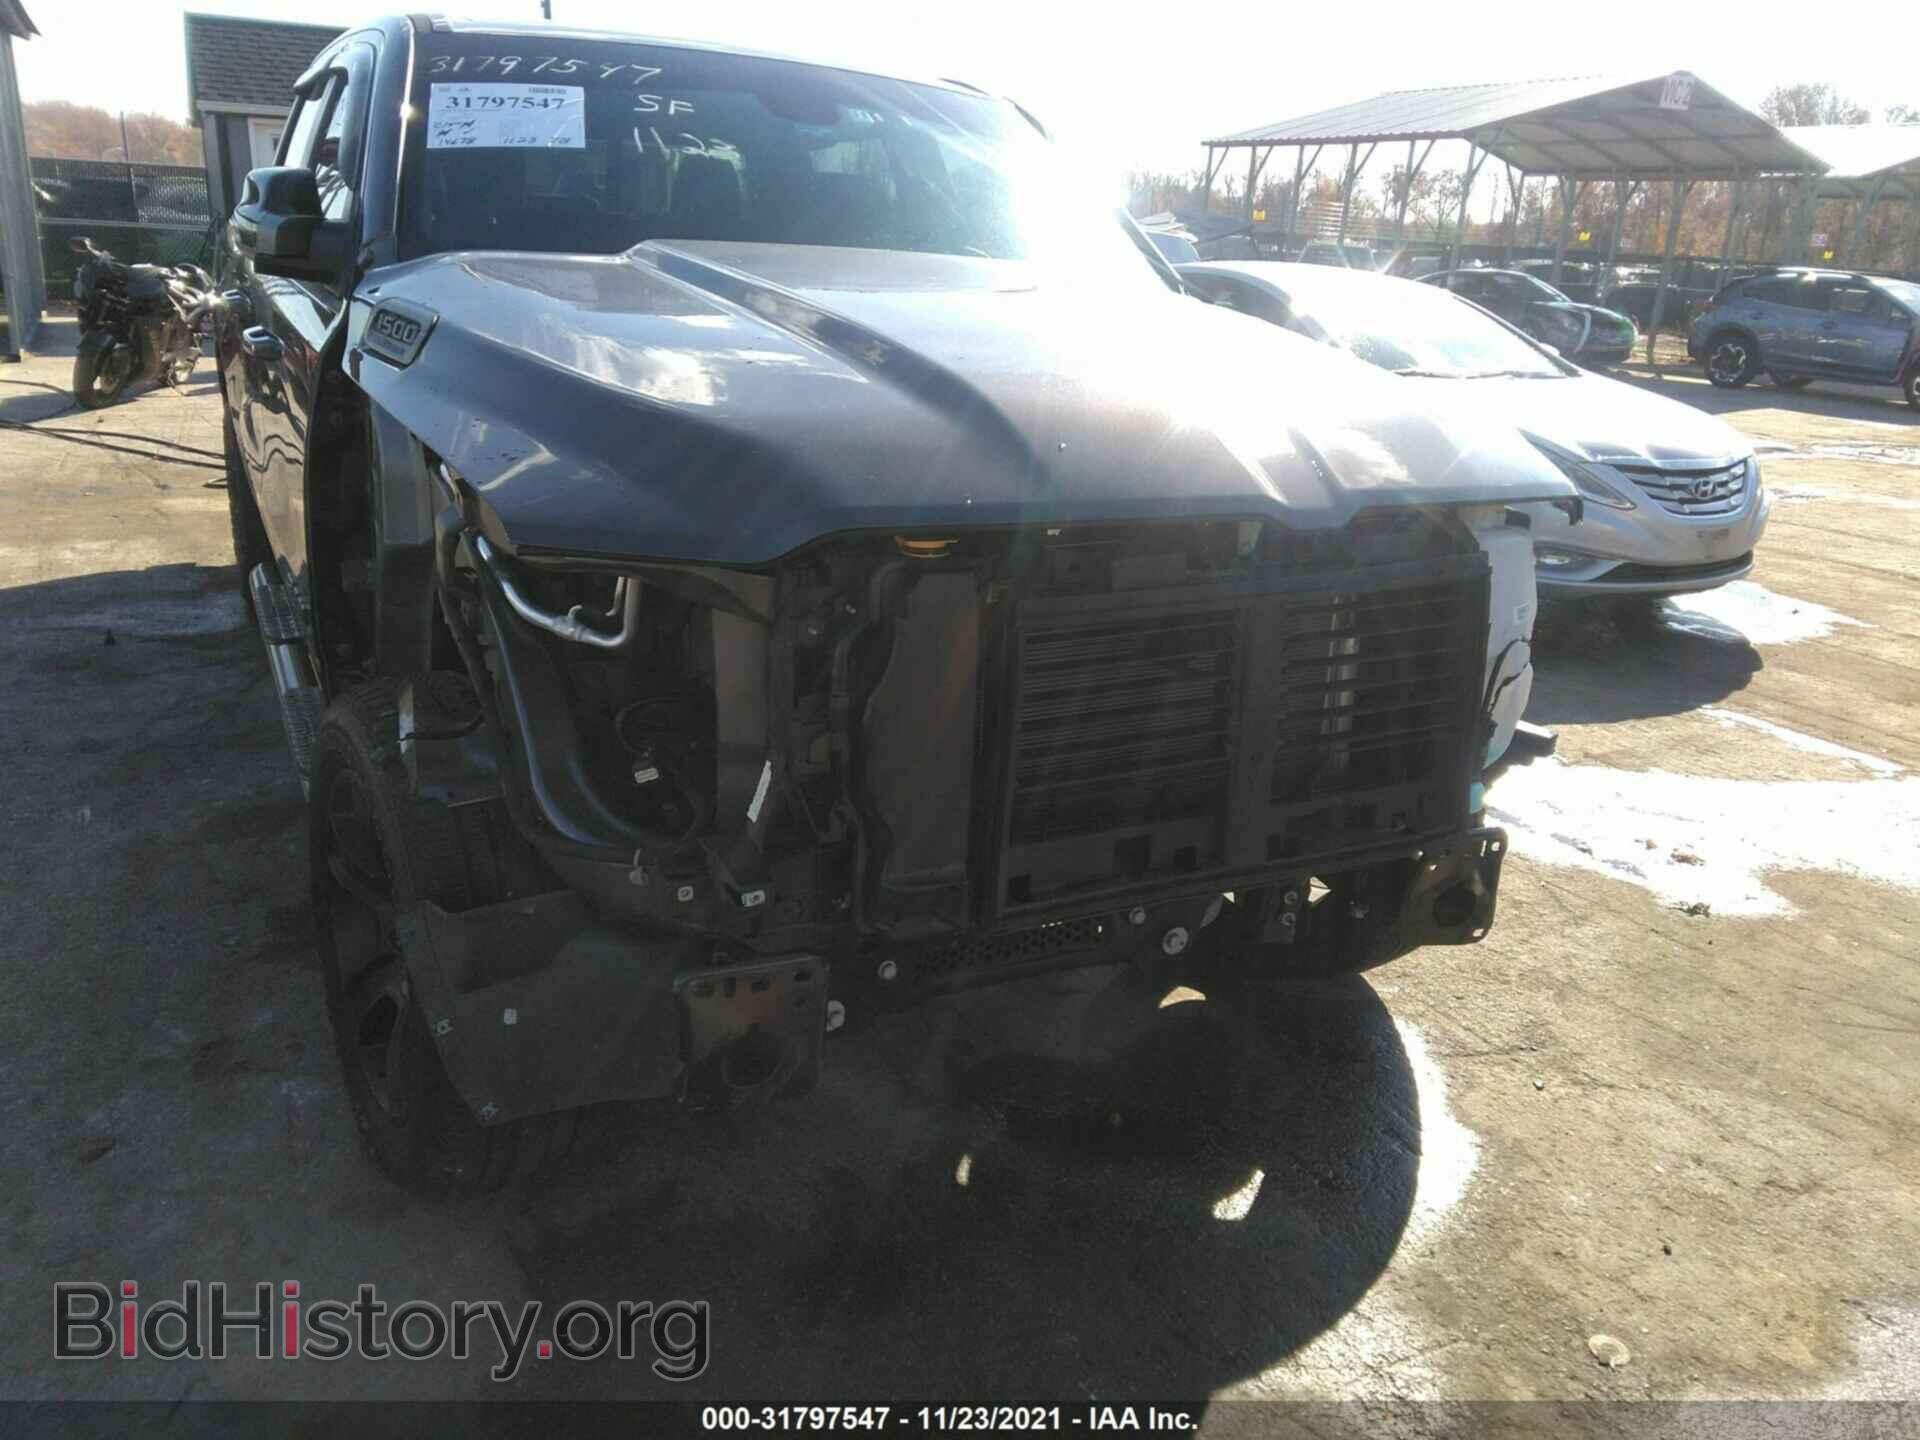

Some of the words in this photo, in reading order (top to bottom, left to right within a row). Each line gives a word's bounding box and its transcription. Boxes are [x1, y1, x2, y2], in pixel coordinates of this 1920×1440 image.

[445, 96, 566, 110] 31797547
[633, 94, 696, 116] SF
[377, 312, 419, 343] 1500
